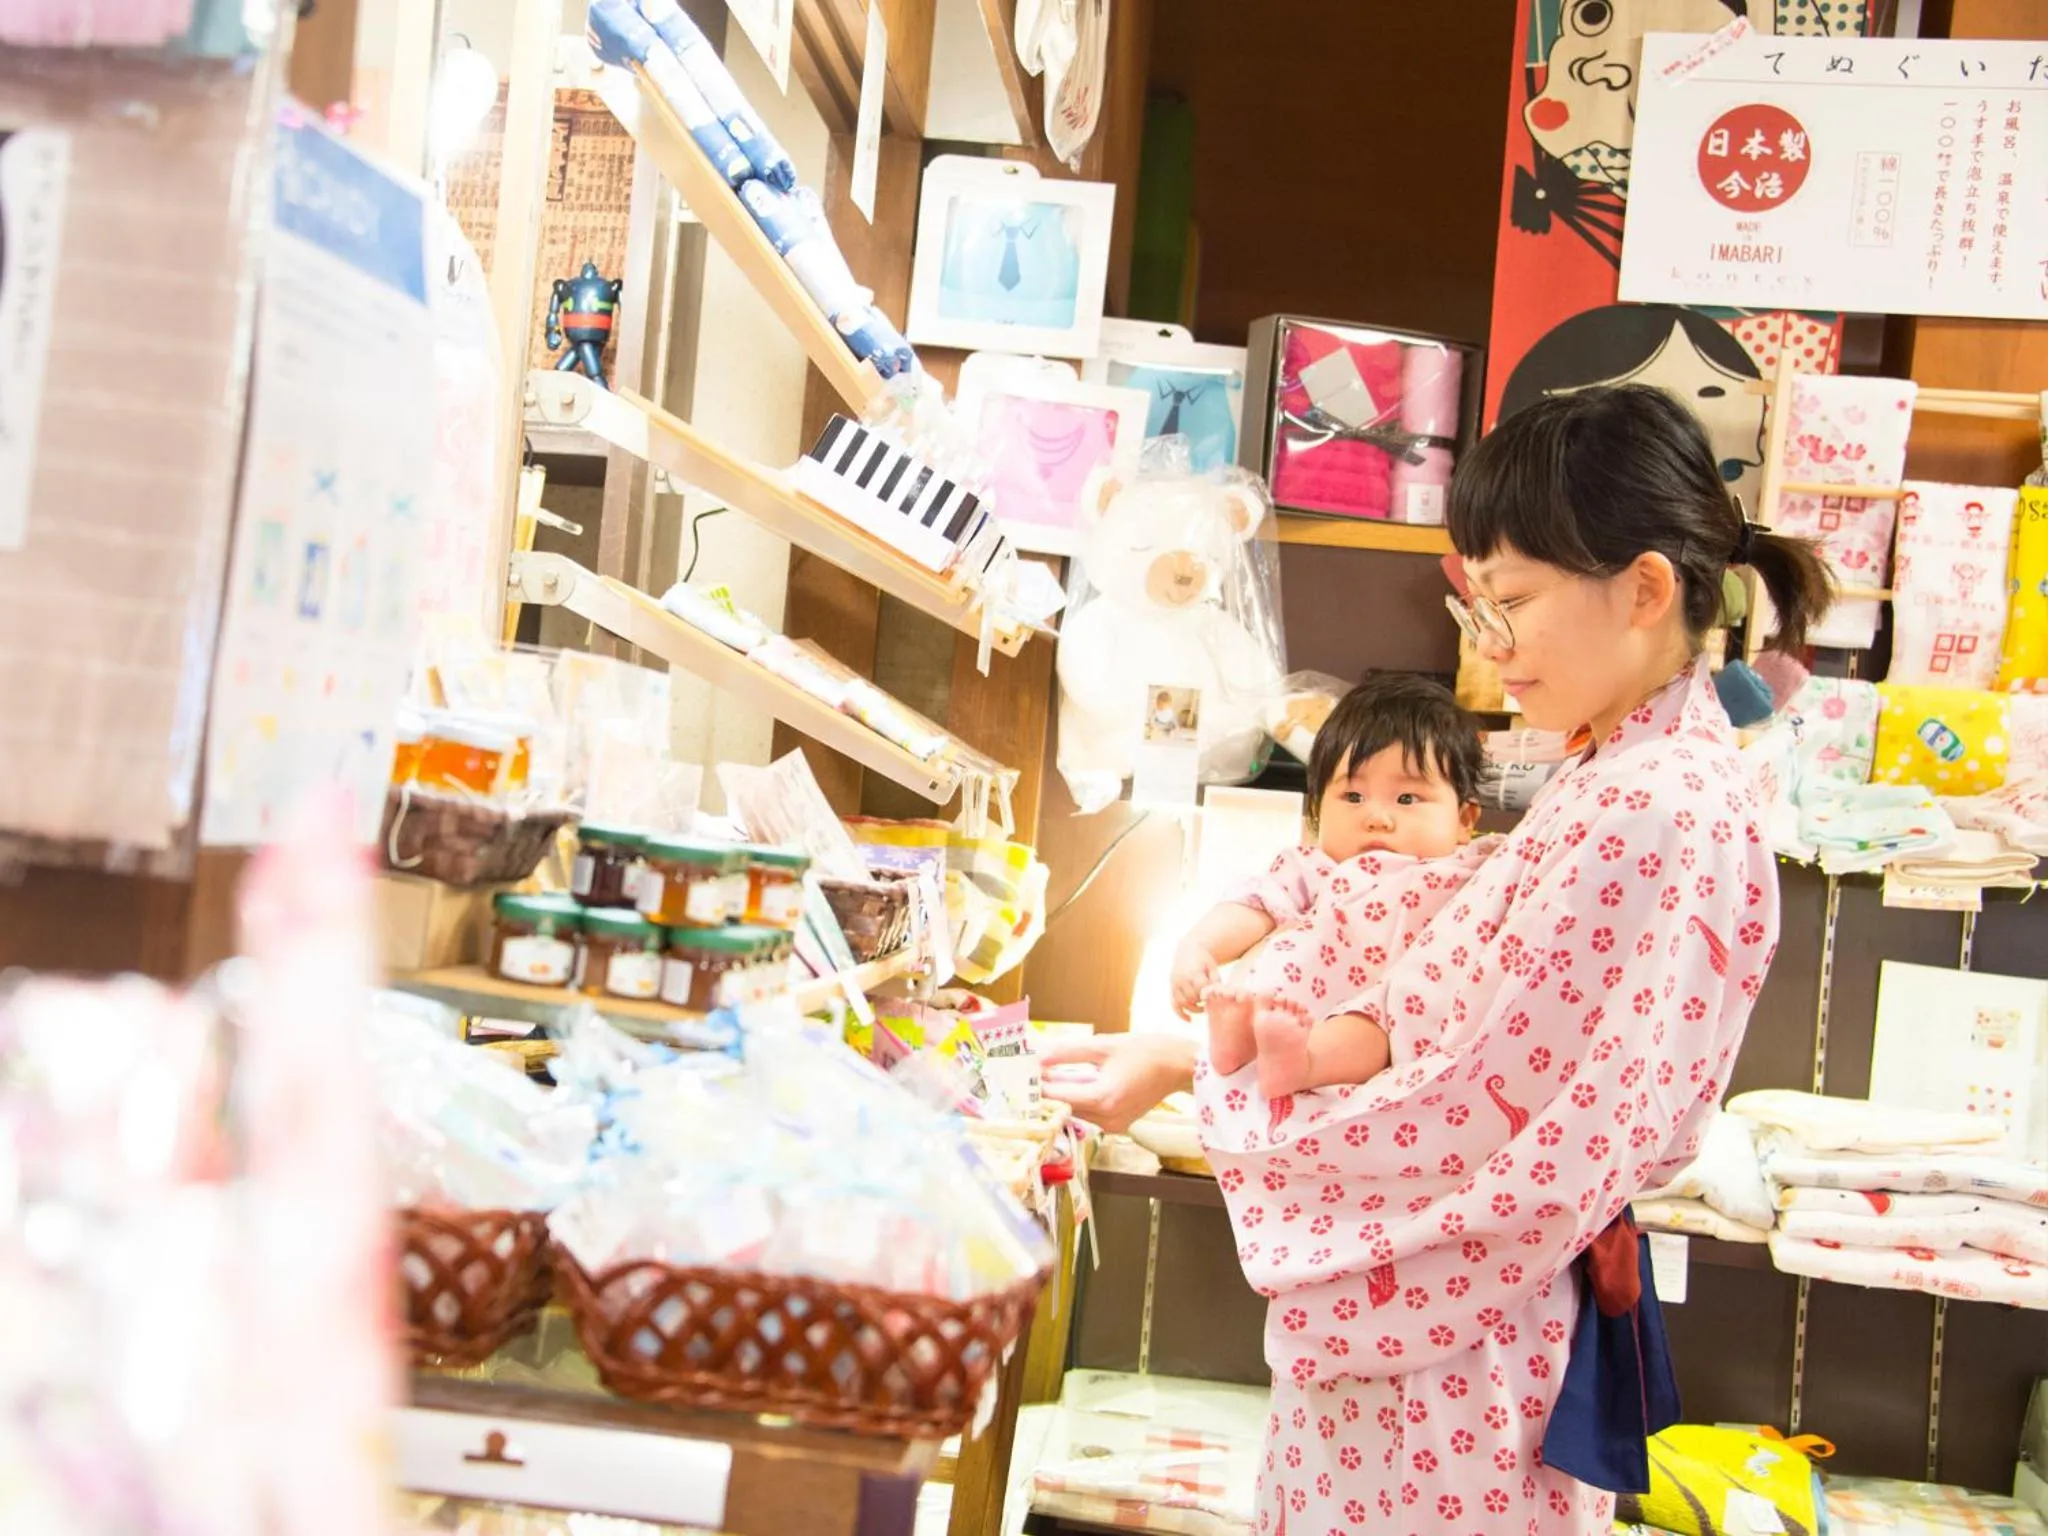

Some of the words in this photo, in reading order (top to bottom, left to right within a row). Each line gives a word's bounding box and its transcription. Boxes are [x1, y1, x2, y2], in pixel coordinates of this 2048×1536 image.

[1706, 127, 1807, 163] 日本製
[1716, 170, 1785, 200] 今治
[1709, 242, 1784, 264] IMABARI
